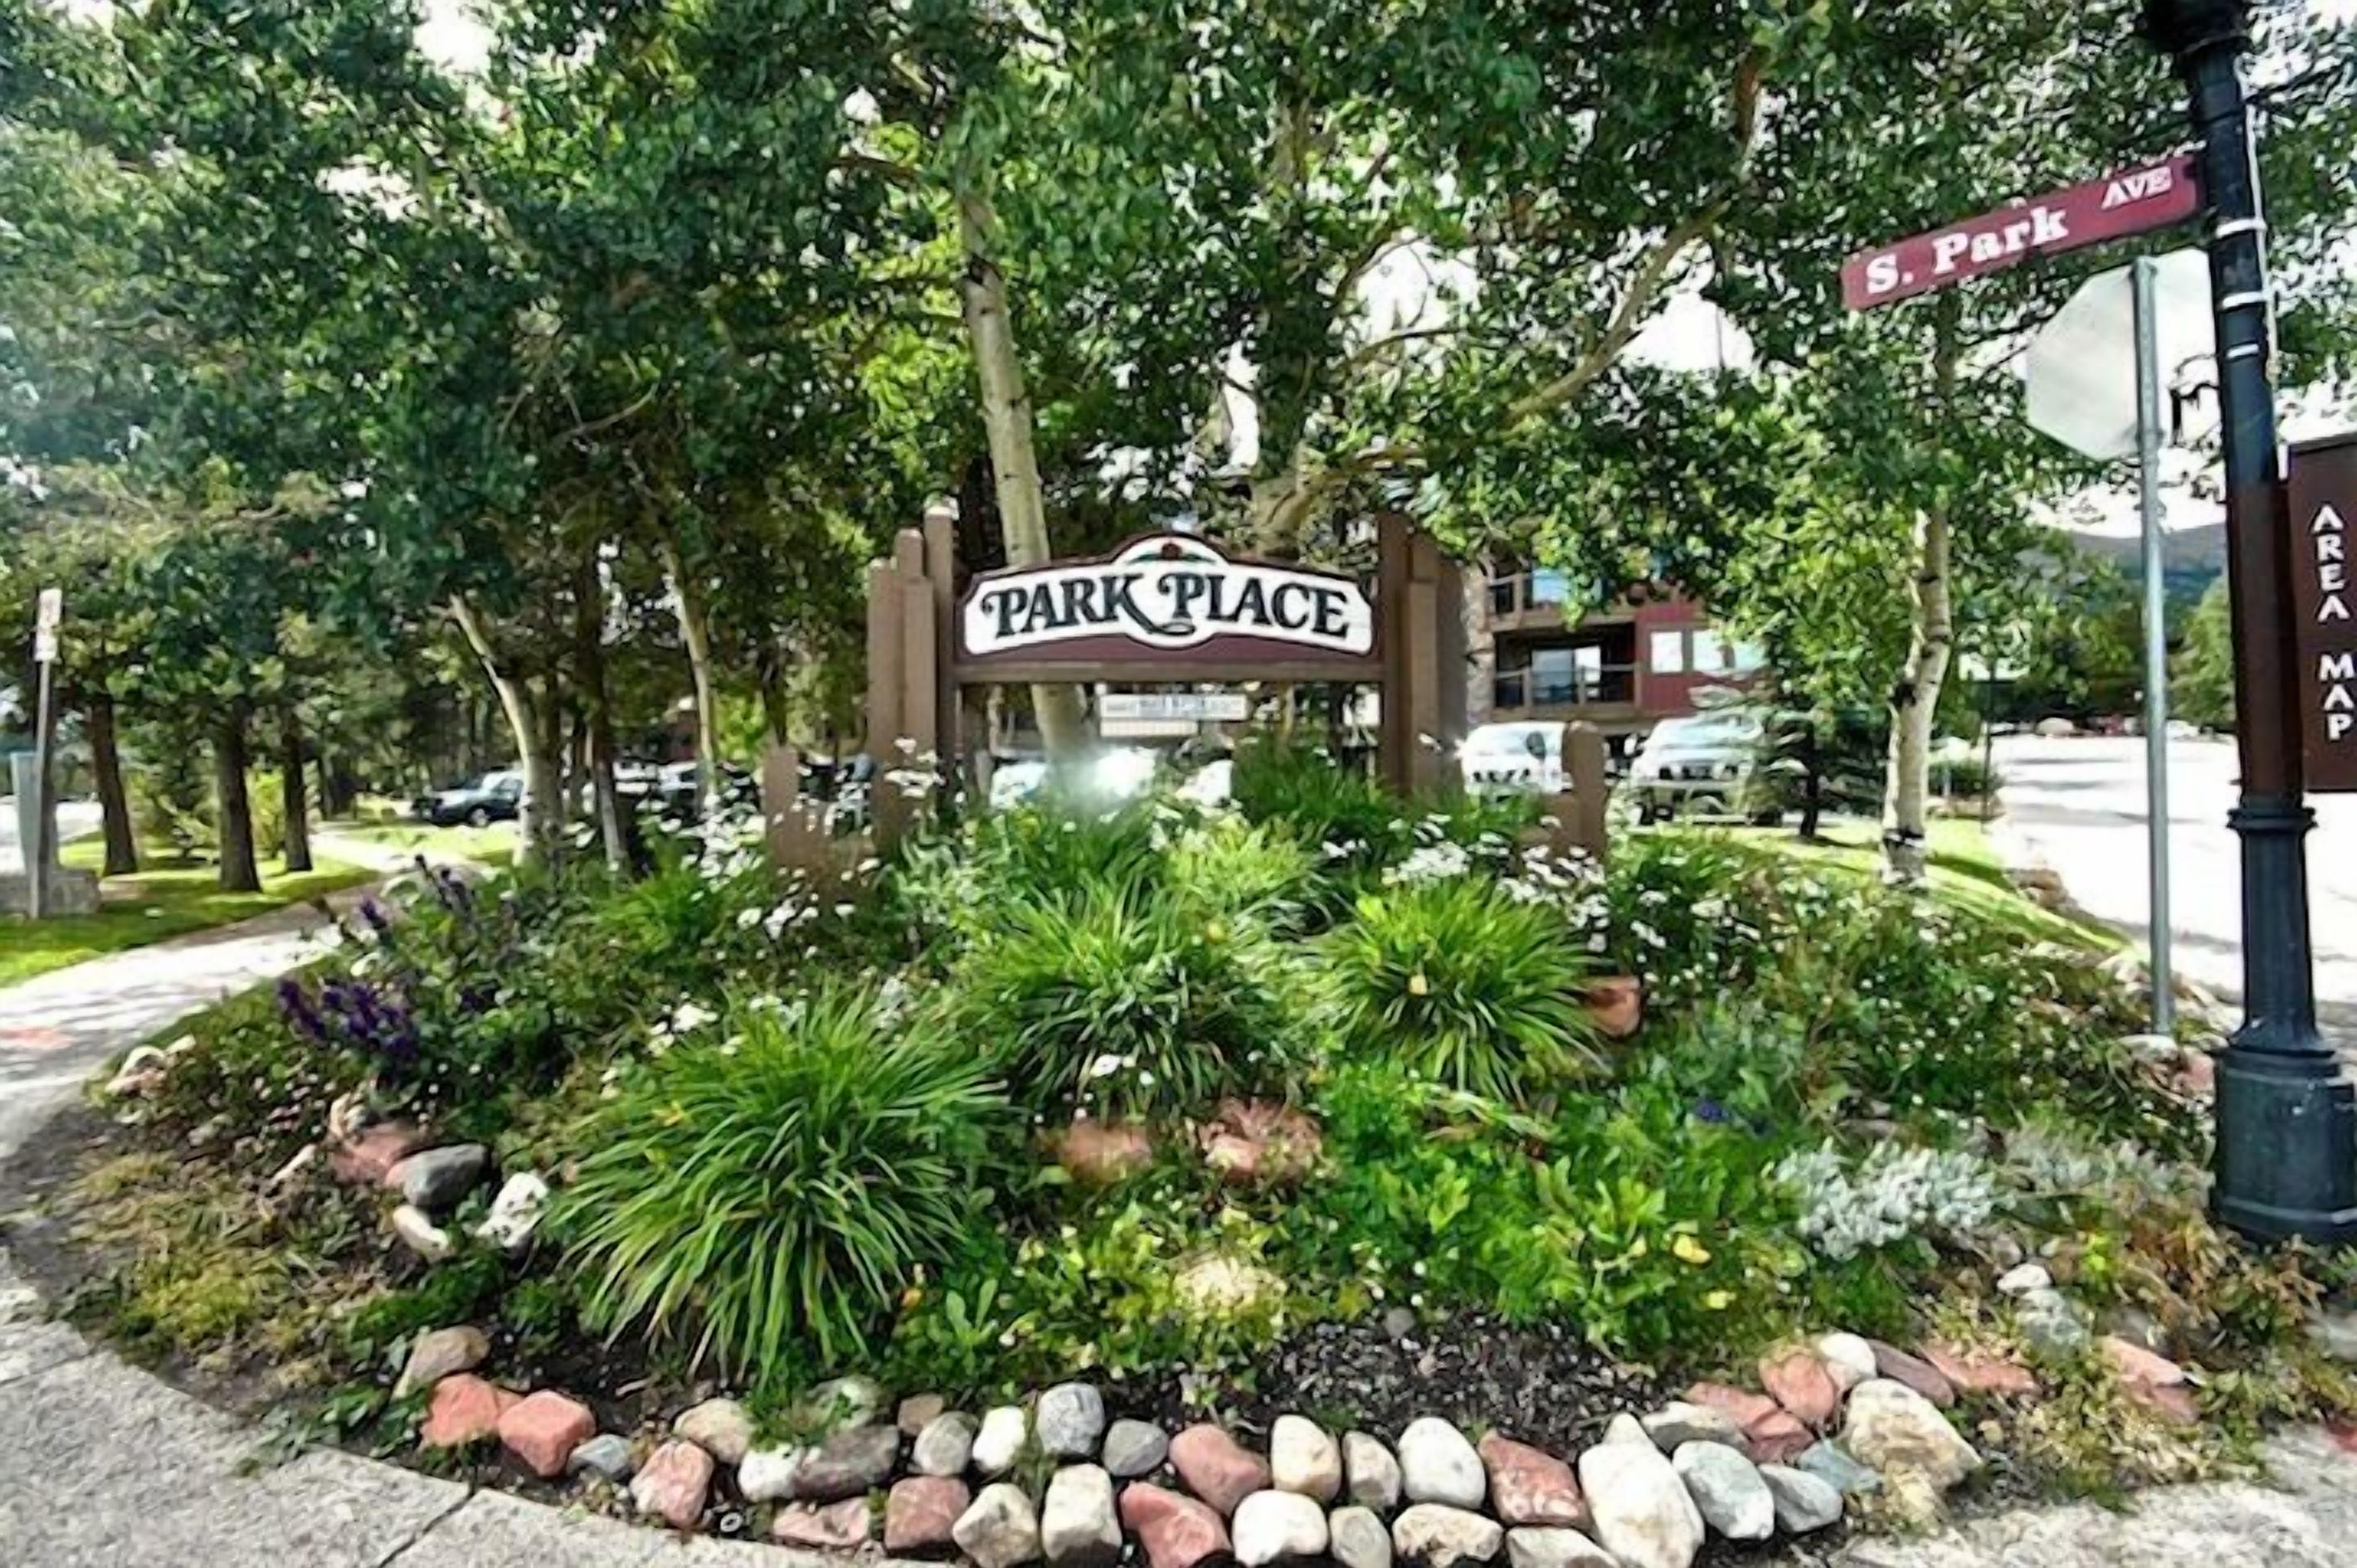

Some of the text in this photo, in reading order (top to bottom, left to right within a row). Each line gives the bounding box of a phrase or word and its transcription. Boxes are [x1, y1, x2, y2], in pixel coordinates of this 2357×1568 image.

[1865, 167, 2174, 295] S. Park AVE
[980, 572, 1350, 639] PARK PLACE
[2313, 504, 2355, 740] AREA MAP
